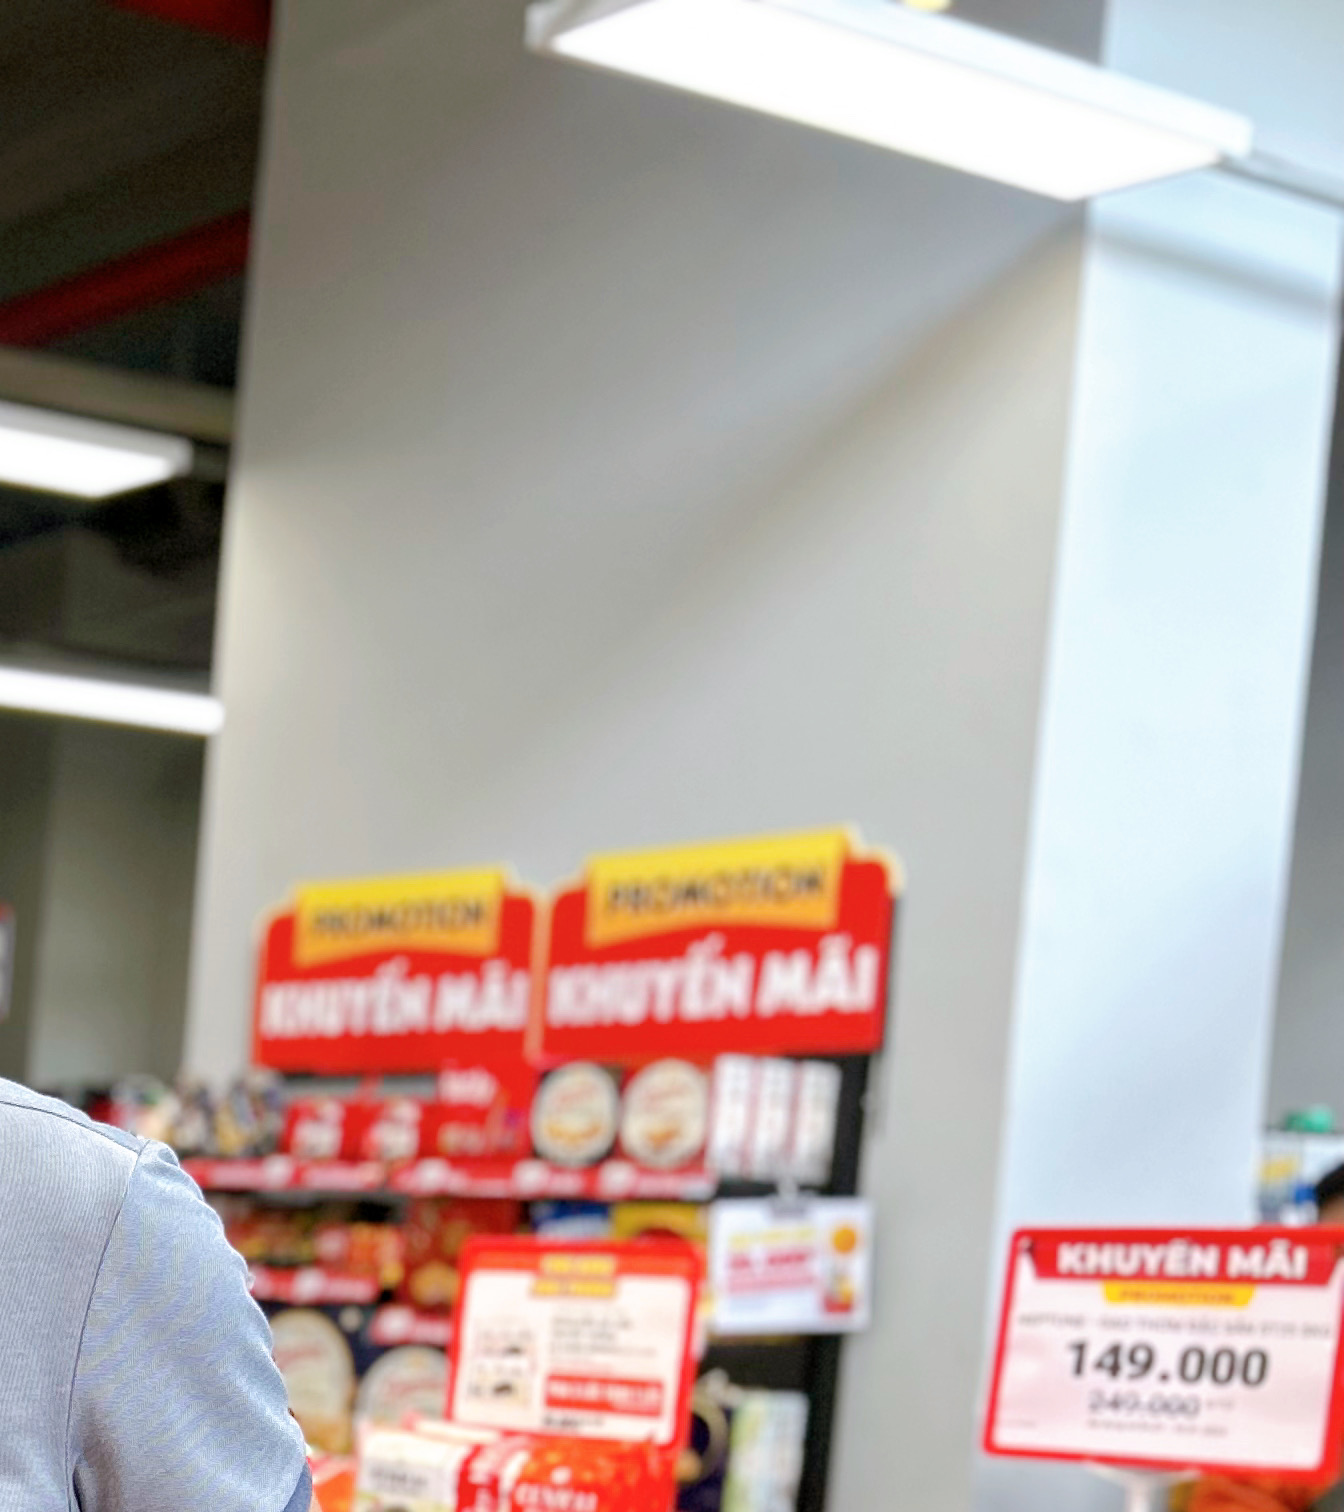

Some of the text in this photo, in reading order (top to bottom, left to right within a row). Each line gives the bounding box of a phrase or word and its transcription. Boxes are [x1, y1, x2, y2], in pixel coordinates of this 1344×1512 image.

[1057, 1236, 1309, 1280] KHUYẾN MÃI
[1068, 1338, 1271, 1388] 149.000
